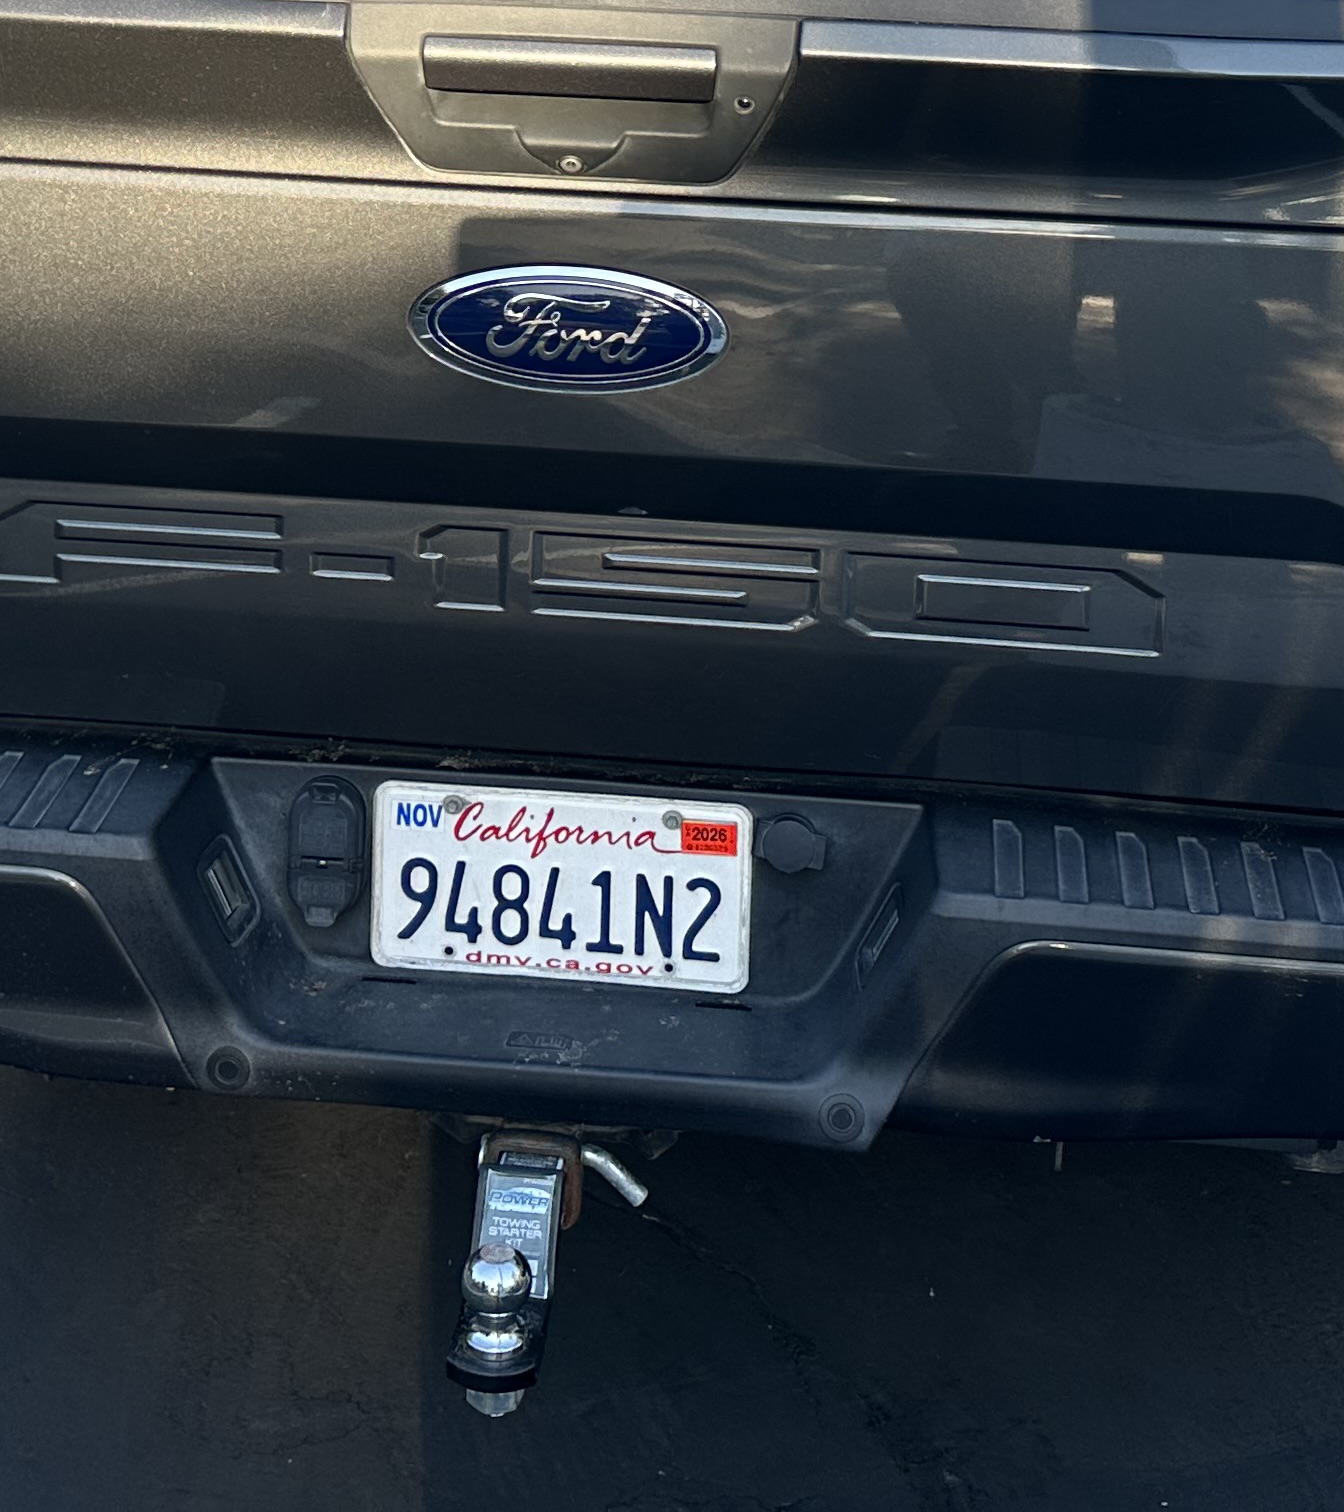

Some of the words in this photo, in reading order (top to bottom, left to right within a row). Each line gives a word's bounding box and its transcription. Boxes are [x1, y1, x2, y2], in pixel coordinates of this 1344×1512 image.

[485, 292, 653, 366] Ford
[396, 802, 443, 828] NOV
[453, 801, 682, 858] California
[691, 826, 728, 843] 2026
[397, 857, 721, 962] 94841N2
[465, 949, 654, 976] dmv.ca.gov
[489, 1191, 550, 1206] POWER
[488, 1226, 542, 1240] STARTER
[493, 1216, 541, 1229] TOWING
